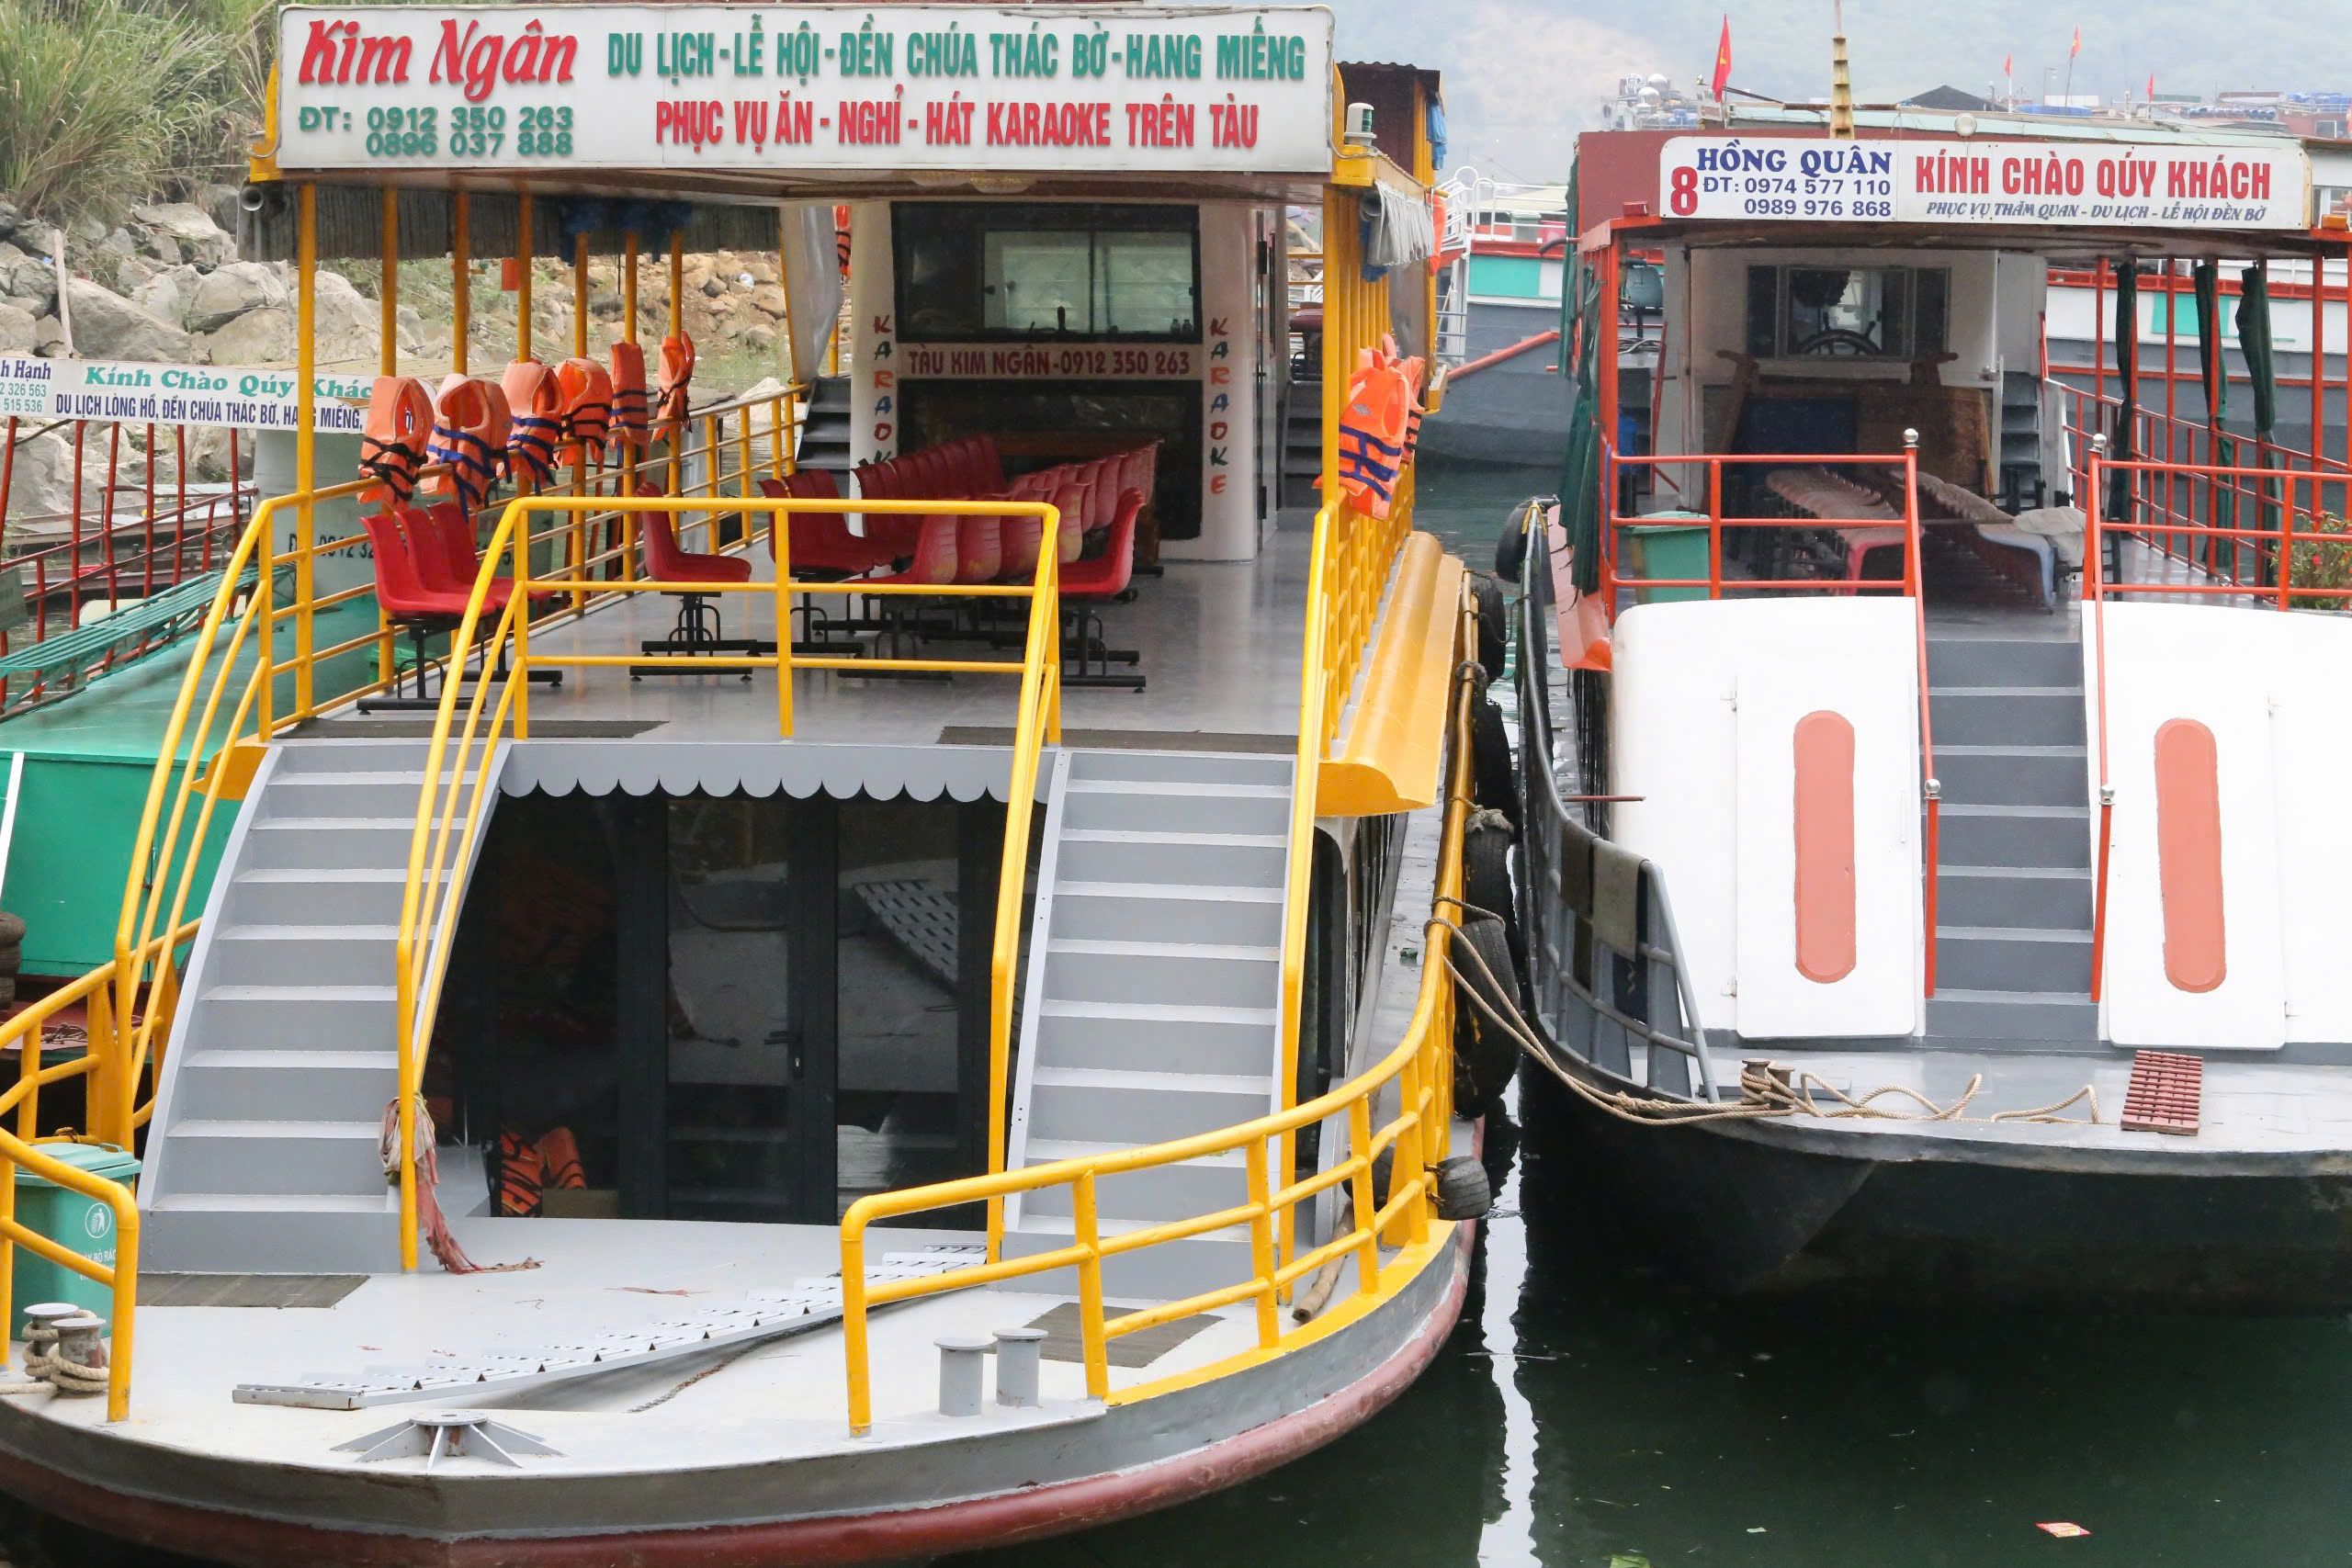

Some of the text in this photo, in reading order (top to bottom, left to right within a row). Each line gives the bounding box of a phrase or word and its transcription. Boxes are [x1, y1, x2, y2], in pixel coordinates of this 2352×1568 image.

[299, 18, 578, 103] Kim Ngân
[607, 33, 642, 75] DU
[907, 21, 978, 77] CHÚA
[989, 21, 1058, 77] THÁC
[1216, 16, 1306, 80] MIẾNG
[299, 106, 574, 131] ĐT: 0912 350 263
[656, 100, 723, 153] PHỤC
[733, 100, 768, 153] VỤ
[774, 90, 813, 144] ĂN
[838, 84, 903, 144] NGHỈ
[925, 90, 975, 145] HÁT
[986, 102, 1111, 146] KARAOKE
[1125, 92, 1195, 147] TRÊN
[1209, 93, 1259, 147] TÀU
[366, 131, 573, 156] 0896 037 888
[1697, 139, 1892, 177] HỒNG QUÂN
[1702, 176, 1891, 196] ĐT: 0974 577 110
[1916, 149, 2271, 199] KÍNH CHÀO QÚY KHÁCH
[1670, 166, 1698, 216] 8
[1745, 198, 1892, 217] 0989 976 868
[1926, 201, 1968, 219] PHỤC
[1970, 203, 1991, 220] VỤ
[2038, 204, 2080, 220] QUAN
[2090, 205, 2112, 218] DU
[2114, 205, 2150, 221] LỊCH
[2182, 204, 2210, 223] HỘI
[2211, 201, 2244, 221] ĐỀN
[2245, 205, 2267, 221] BỜ
[14, 360, 51, 382] Hạnh
[909, 344, 944, 376] TÀU
[951, 351, 987, 375] KIM
[1113, 350, 1148, 375] 350
[1154, 350, 1192, 375] 263
[8, 382, 26, 396] 326
[28, 383, 47, 398] 563
[85, 366, 373, 399] Kính Chào Qúy Khác
[874, 315, 894, 463] KARAOK
[4, 398, 42, 412] 515 536
[56, 393, 72, 414] DU
[75, 394, 102, 418] LỊCH
[105, 392, 136, 417] LÒNG
[163, 394, 187, 420] ĐỀN
[190, 397, 222, 423] CHÚA
[226, 399, 256, 424] THÁC
[260, 400, 279, 427] BỜ,
[283, 404, 316, 427] HA
[321, 402, 363, 433] MIẾNG,
[1209, 317, 1230, 495] KARAOKE
